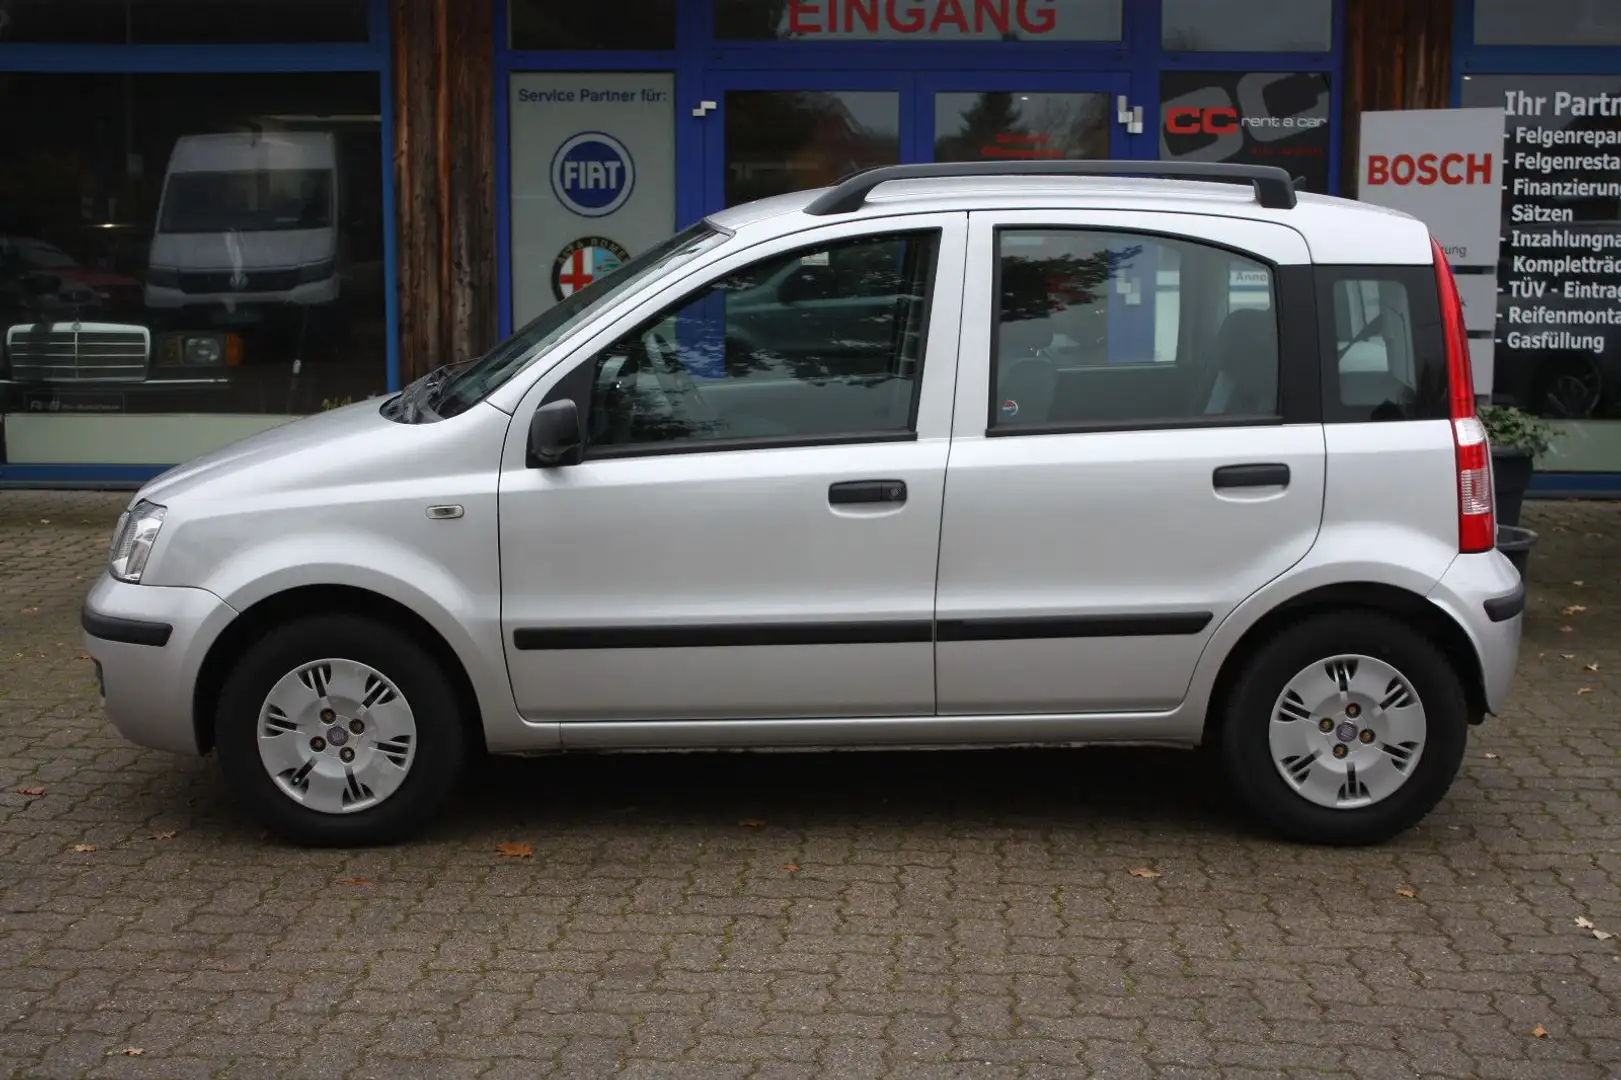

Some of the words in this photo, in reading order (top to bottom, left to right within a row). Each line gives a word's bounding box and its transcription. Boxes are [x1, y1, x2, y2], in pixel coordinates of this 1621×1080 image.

[789, 0, 1056, 33] EINGANG
[518, 89, 574, 102] Service
[580, 89, 635, 102] Partner
[640, 89, 666, 102] für:
[1505, 90, 1547, 116] Ihr
[1554, 91, 1621, 116] Partn
[1241, 116, 1280, 127] rent
[1296, 117, 1327, 127] car
[1367, 152, 1492, 185] BOSCH
[1514, 152, 1620, 174] Felgenresta
[564, 161, 621, 190] FIAT
[1513, 178, 1621, 196] Finanzierun
[1511, 204, 1573, 222] Sätzen
[1511, 229, 1621, 252] Inzahlungna
[1509, 276, 1546, 298] TÜV
[1508, 305, 1621, 324] Reifenmonta
[1507, 331, 1604, 353] Gasfüllung
